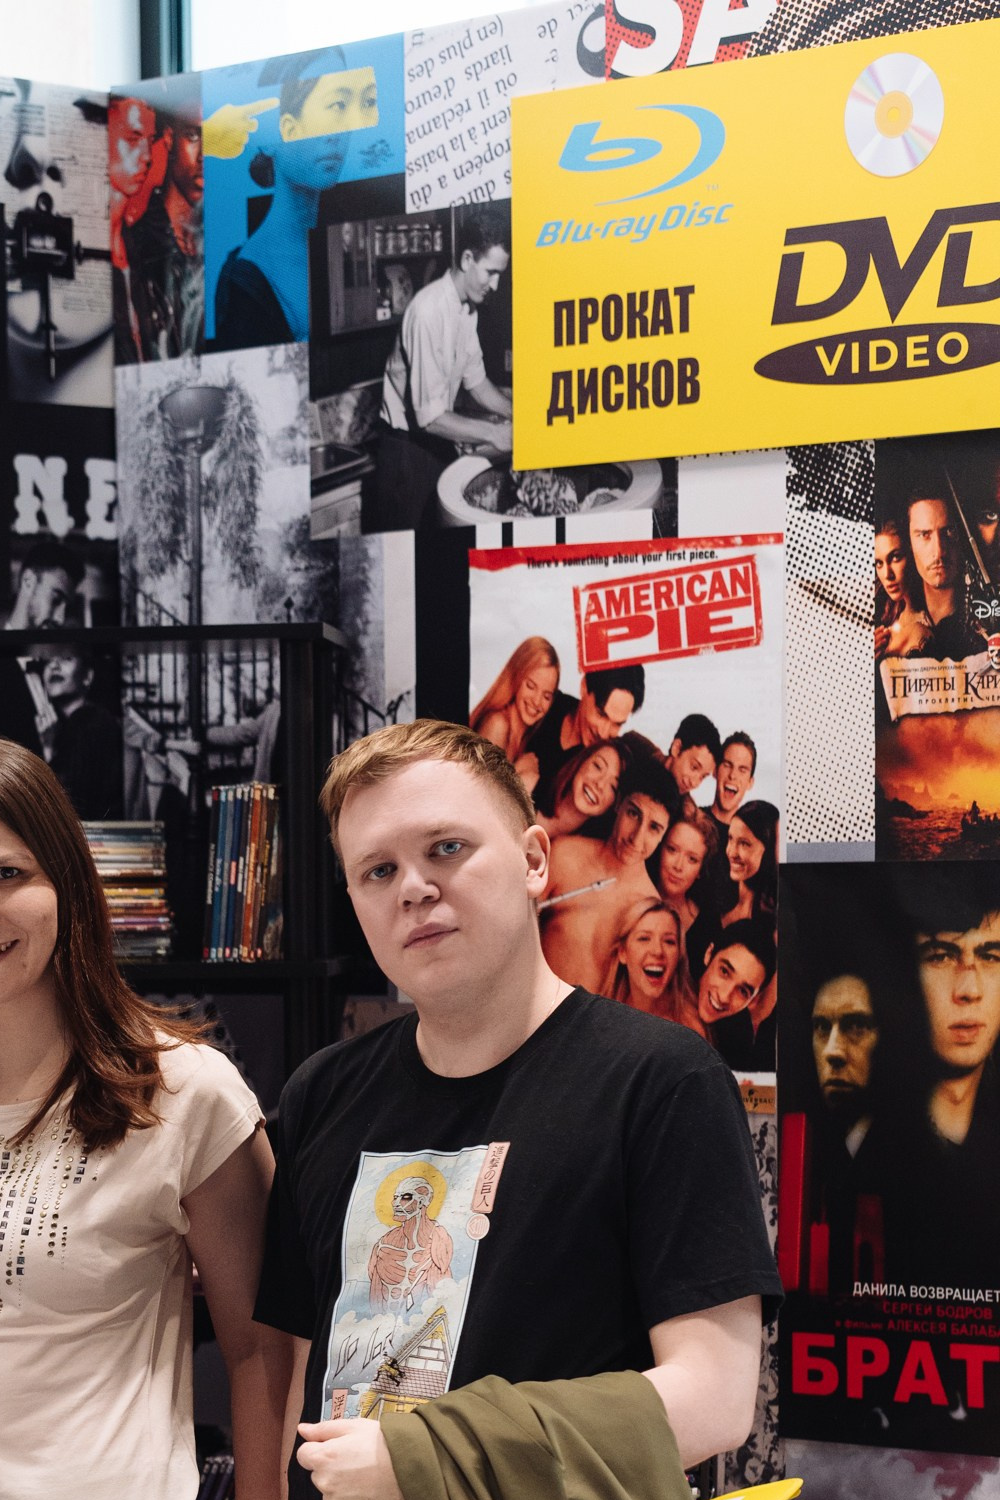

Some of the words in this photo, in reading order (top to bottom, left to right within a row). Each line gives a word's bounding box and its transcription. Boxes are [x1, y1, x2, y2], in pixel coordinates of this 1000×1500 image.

[476, 14, 504, 39] (en
[438, 28, 474, 65] plus
[407, 55, 435, 83] des
[464, 44, 513, 81] liards
[495, 72, 518, 99] où
[477, 90, 491, 110] il
[450, 134, 467, 152] la
[468, 126, 478, 146] à
[410, 182, 433, 210] dû
[437, 174, 448, 190] a
[535, 213, 658, 248] Blu-ray
[657, 201, 735, 233] Disc
[771, 201, 1000, 326] DVD
[553, 284, 696, 349] ПРОКАТ
[815, 331, 970, 378] VIDEO
[546, 356, 701, 427] ДИСКОВ
[526, 556, 559, 570] There's
[562, 554, 609, 569] something
[612, 551, 639, 564] about
[642, 551, 663, 566] your
[665, 548, 686, 561] first
[689, 548, 719, 563] piece.
[583, 564, 752, 624] AMERICAN
[583, 595, 755, 664] PIE
[890, 675, 955, 700] ПИРАТЫ
[852, 1281, 907, 1297] ДАНИЛА
[936, 1305, 993, 1320] БОДРОВ
[791, 1332, 1000, 1410] БРАТ
